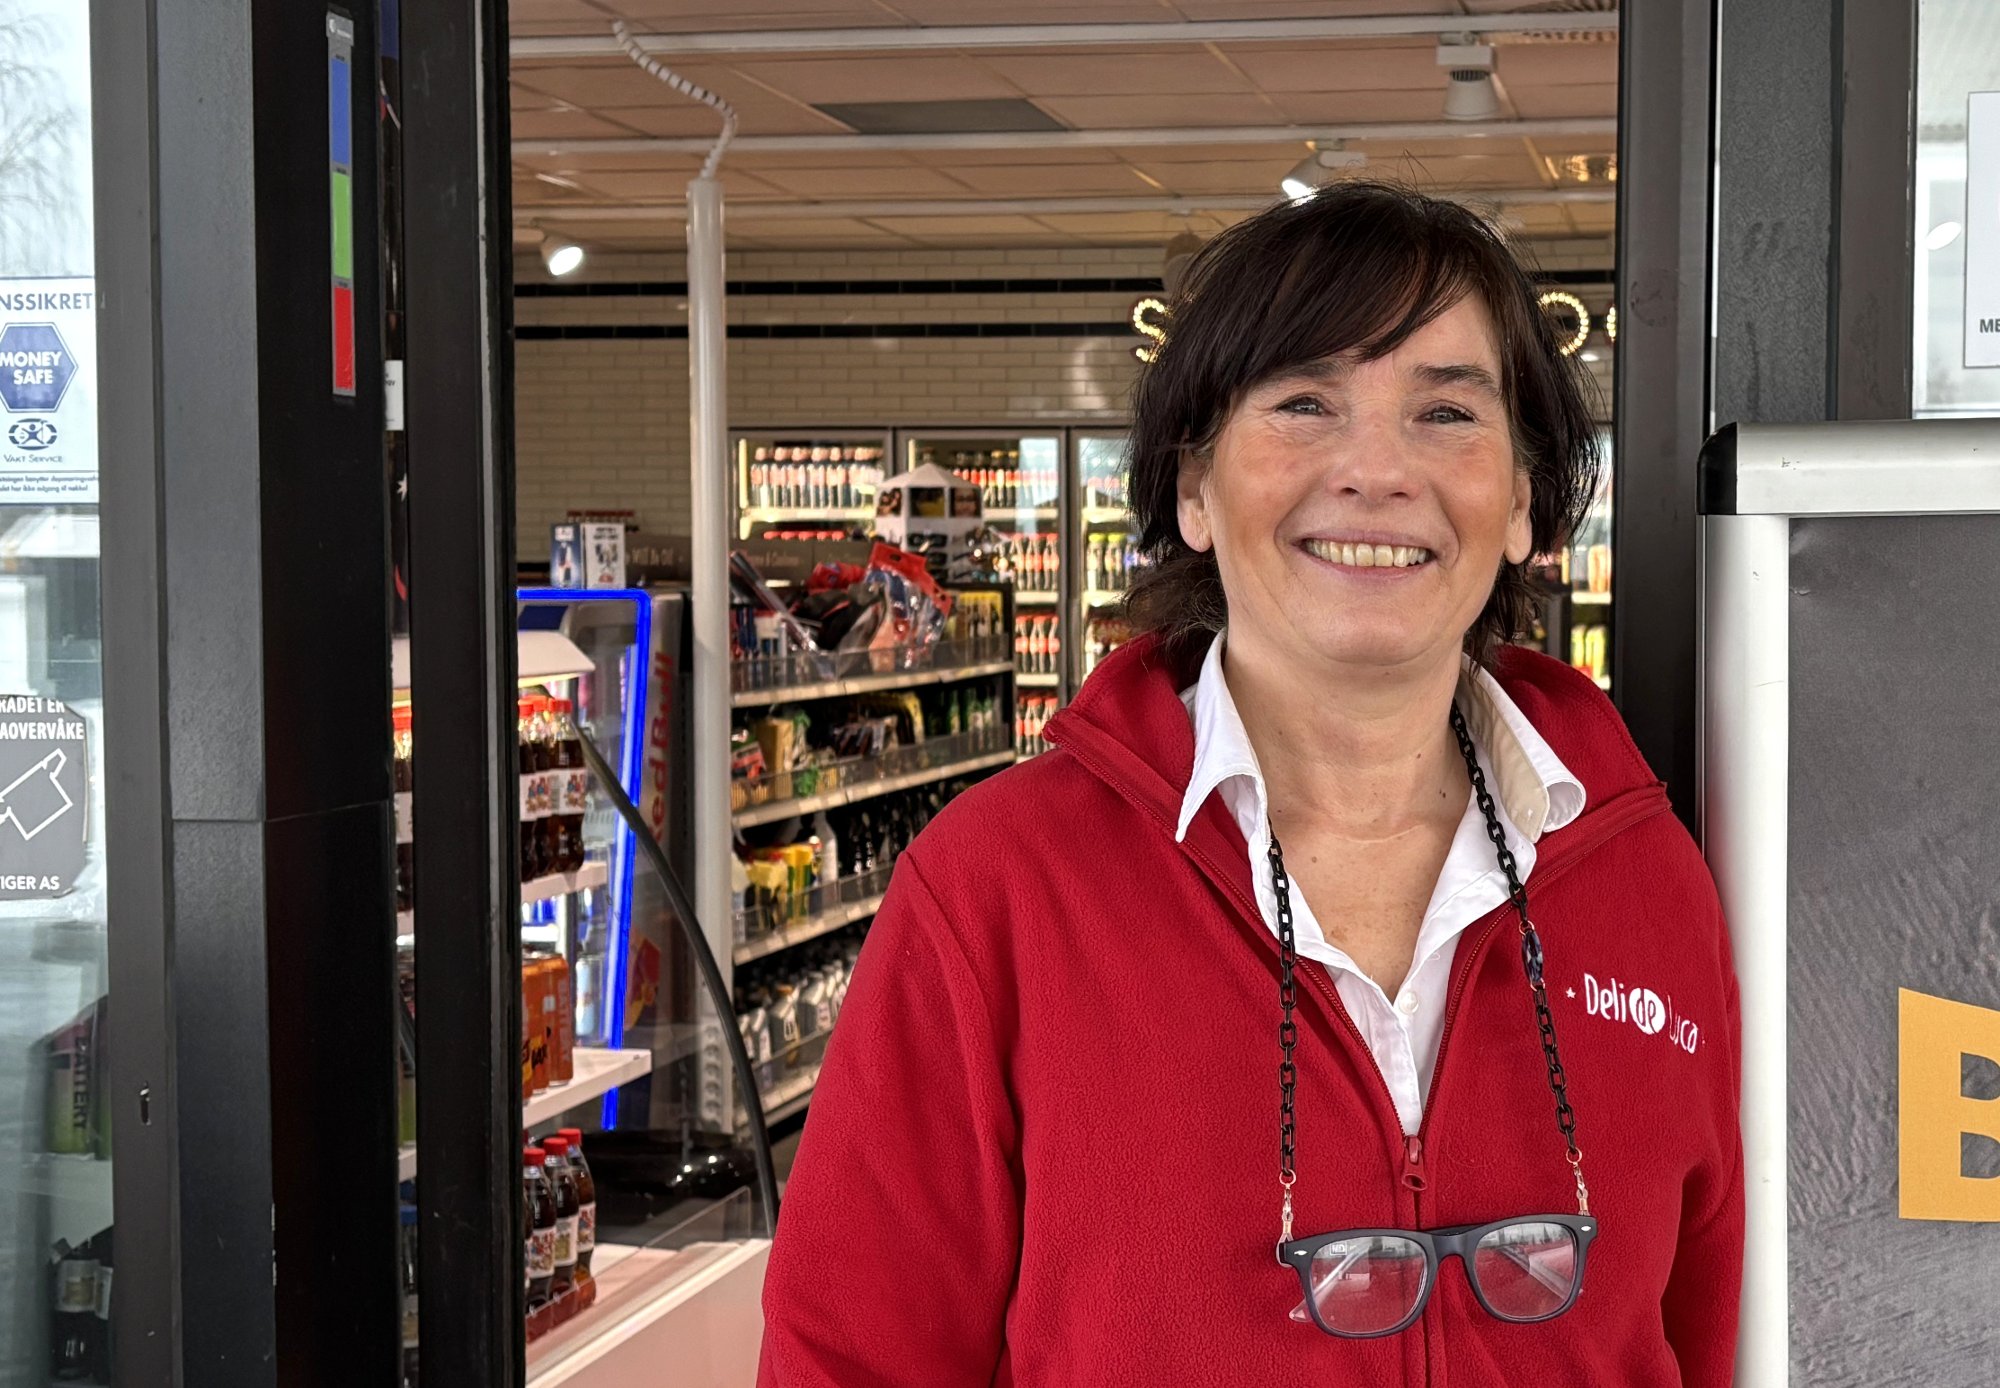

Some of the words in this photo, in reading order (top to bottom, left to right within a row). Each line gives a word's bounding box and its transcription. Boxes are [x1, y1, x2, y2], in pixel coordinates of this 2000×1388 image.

[0, 351, 62, 368] MONEY
[13, 368, 53, 386] SAFE
[0, 874, 36, 890] IGER
[39, 874, 60, 890] AS
[1584, 972, 1627, 1023] Deli
[1667, 994, 1699, 1055] Luca
